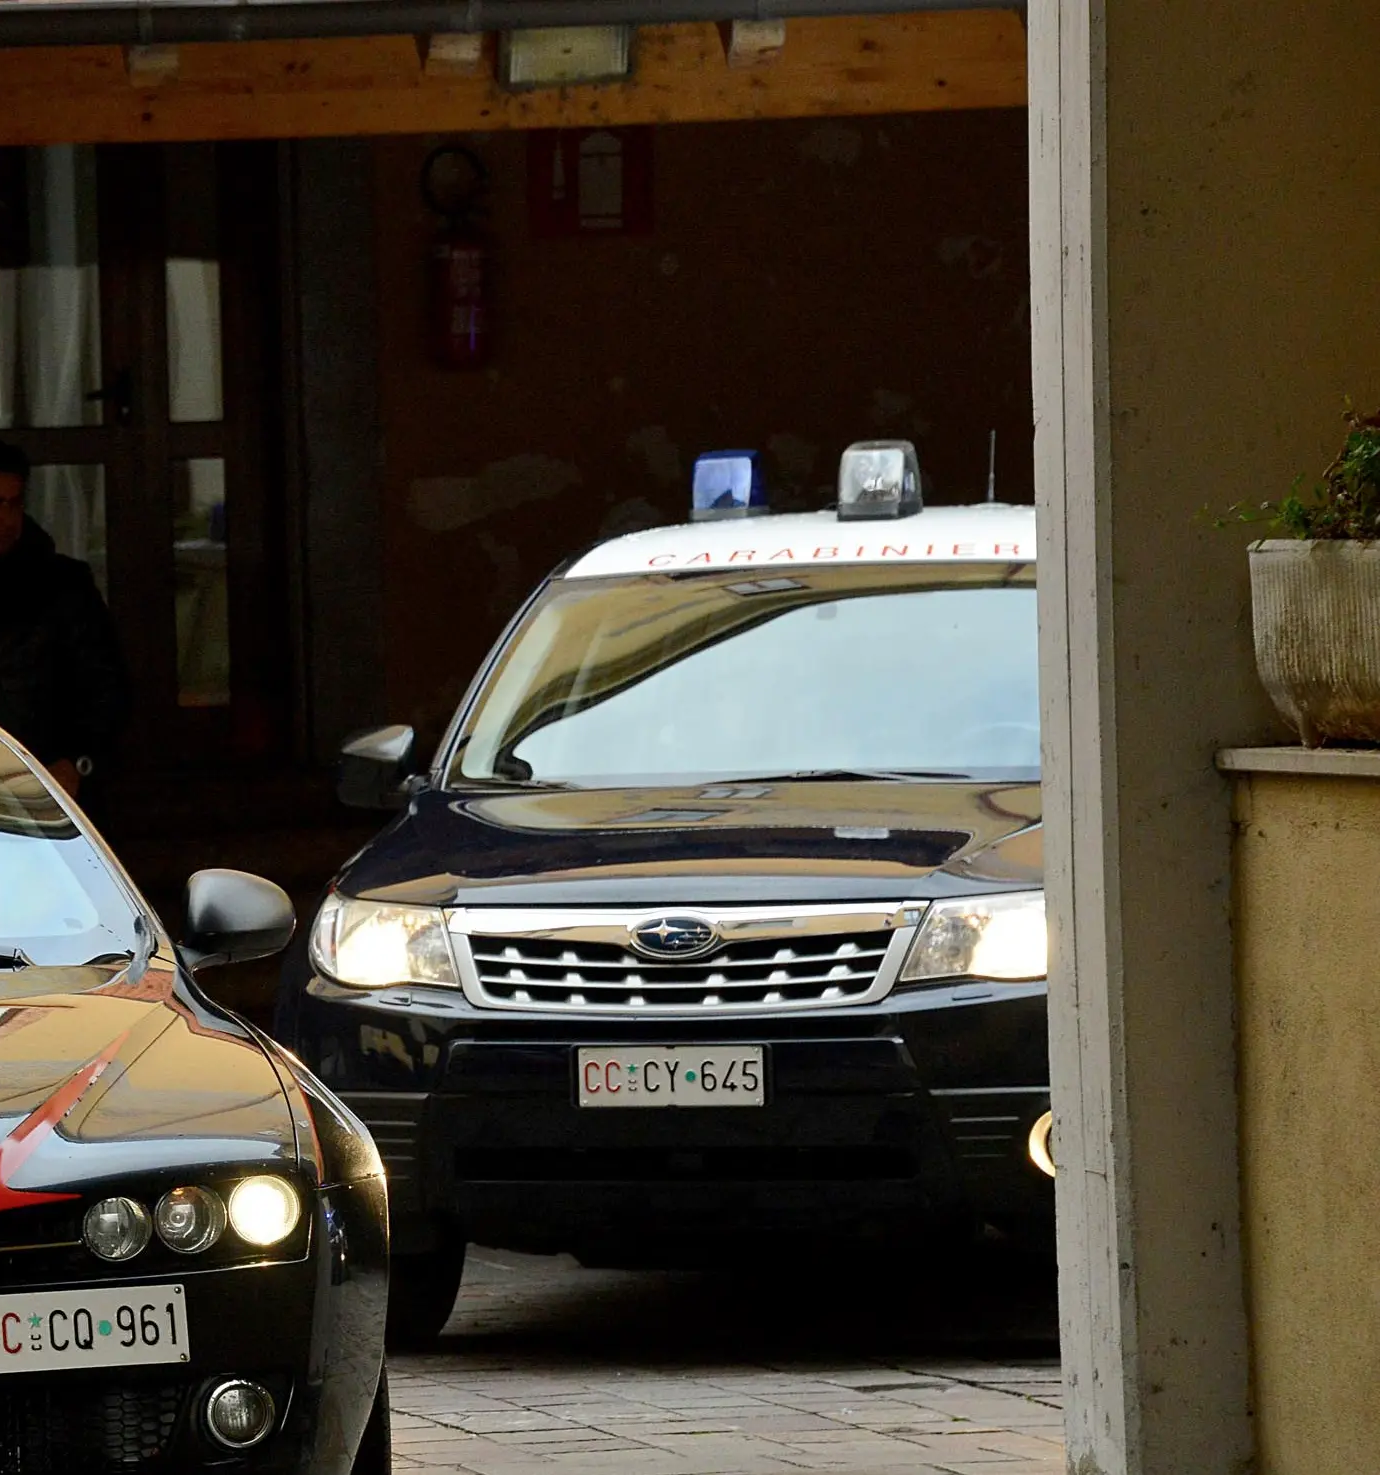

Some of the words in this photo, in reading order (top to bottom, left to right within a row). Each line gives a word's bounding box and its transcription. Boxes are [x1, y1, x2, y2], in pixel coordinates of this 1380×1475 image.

[648, 543, 1020, 566] CARABINIER
[584, 1061, 621, 1093] CC
[643, 1060, 680, 1092] CY
[700, 1060, 759, 1092] 645
[48, 1308, 94, 1351] CQ
[116, 1303, 177, 1347] 961
